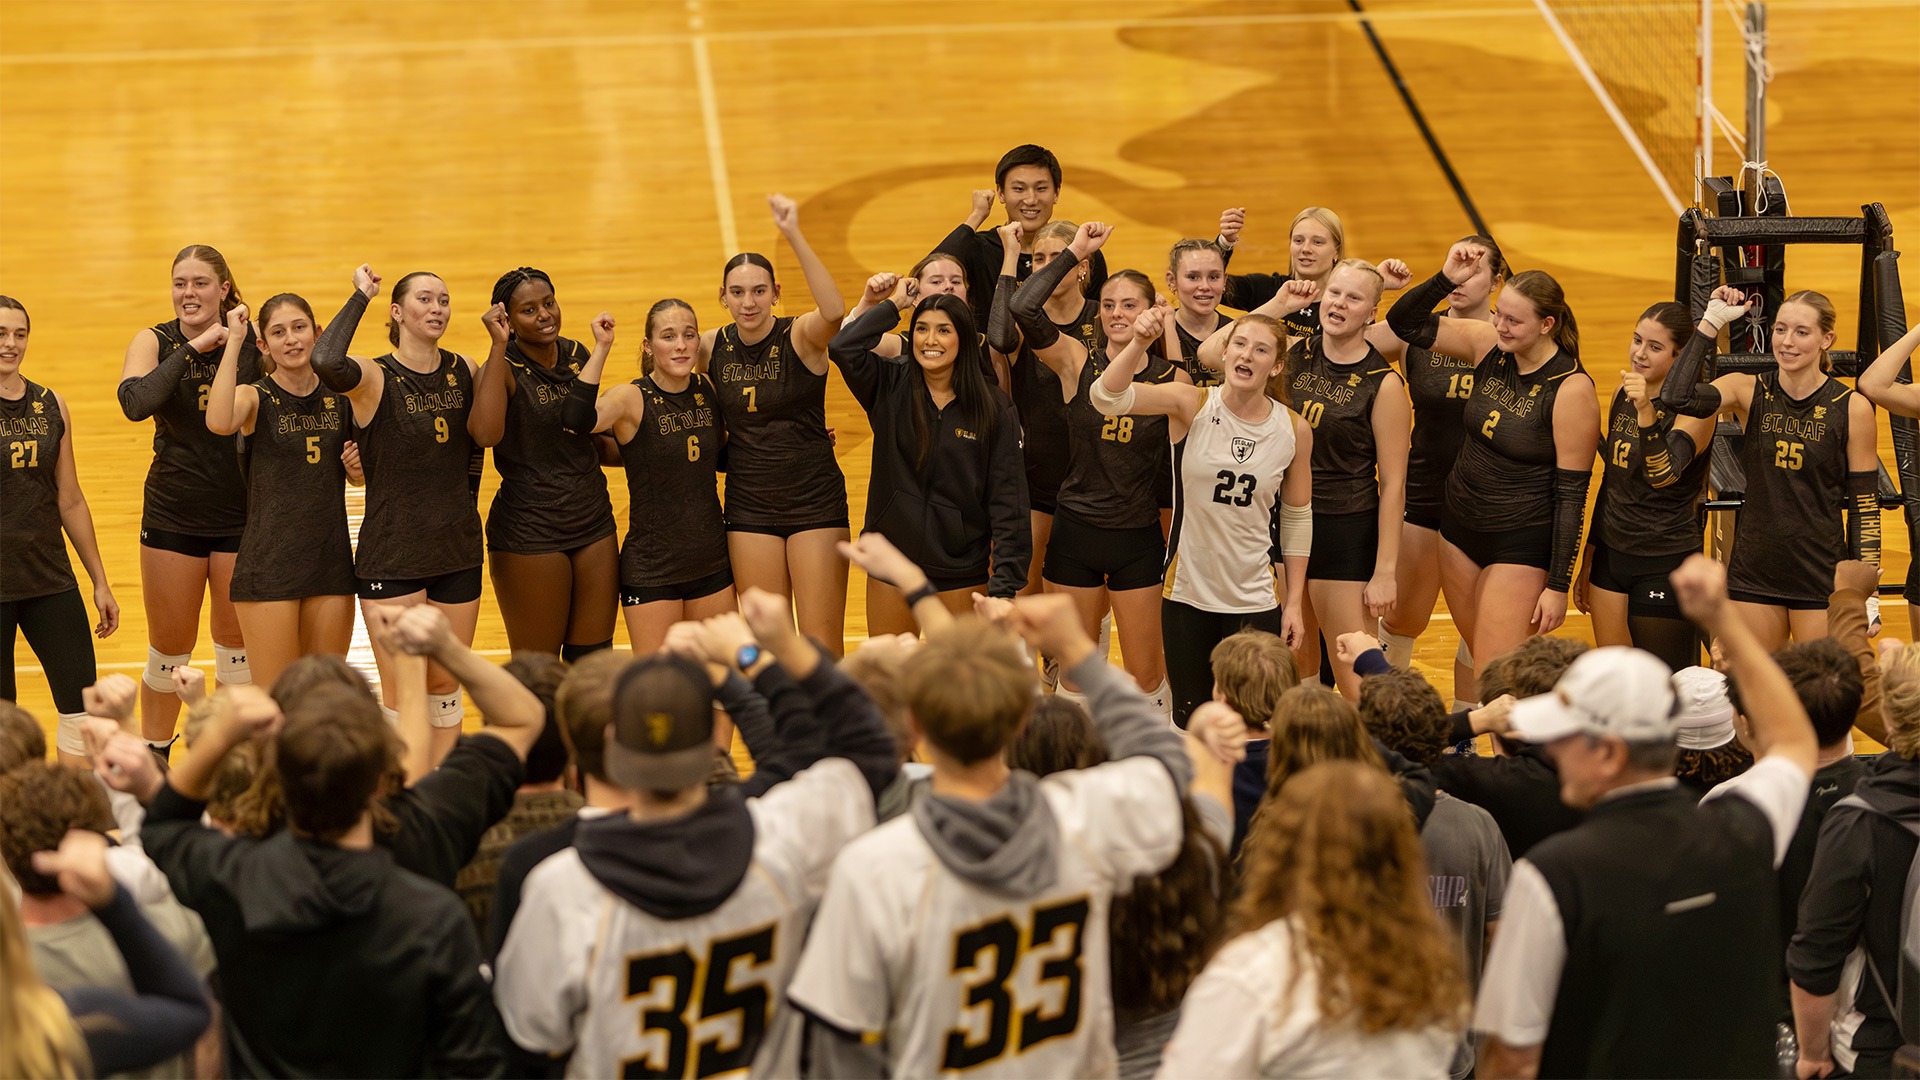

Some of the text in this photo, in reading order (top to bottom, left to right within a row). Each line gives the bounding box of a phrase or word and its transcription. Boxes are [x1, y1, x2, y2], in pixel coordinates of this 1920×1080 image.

[722, 361, 780, 383] ST. OLAF
[1446, 373, 1474, 400] 19
[405, 390, 464, 414] ST. OLAF
[742, 386, 758, 413] 7
[1293, 372, 1354, 407] ST. OLAF
[1482, 377, 1535, 418] ST. OLAF
[11, 416, 49, 436] OLAF
[278, 411, 340, 435] ST. OLAF
[657, 407, 713, 436] ST. OLAF
[1101, 415, 1134, 444] 28
[1301, 400, 1325, 430] 10
[1481, 410, 1501, 440] 2
[1761, 413, 1827, 442] ST. OLAF
[434, 416, 450, 444] 9
[10, 440, 39, 469] 27
[305, 436, 321, 464] 5
[687, 435, 700, 462] 6
[1612, 439, 1632, 469] 12
[1775, 440, 1805, 471] 25
[1213, 469, 1258, 508] 23
[1860, 515, 1881, 543] YAH!
[940, 892, 1092, 1074] 33
[618, 919, 781, 1080] 35
